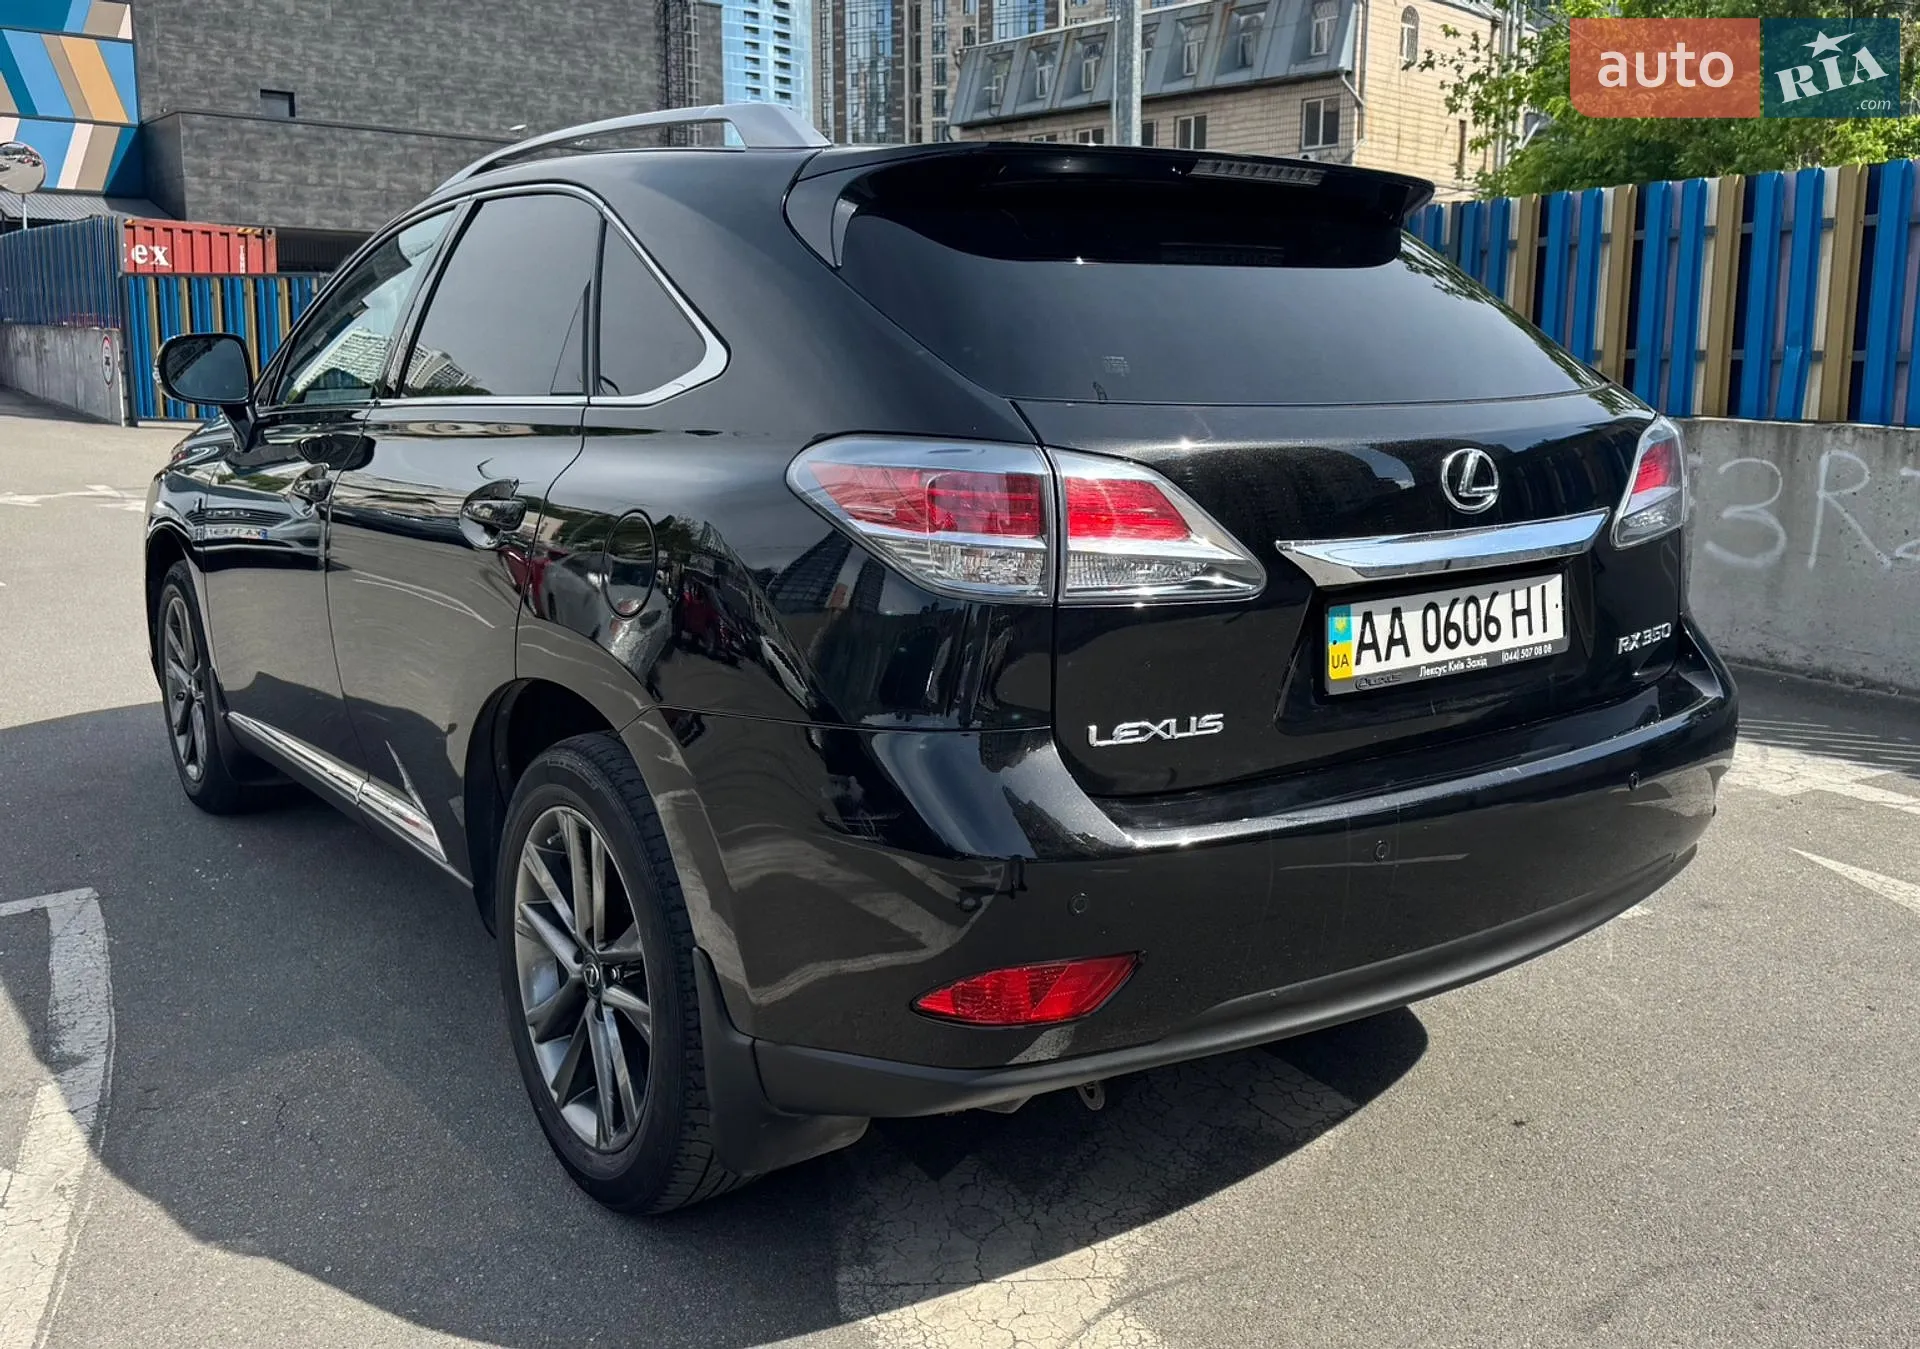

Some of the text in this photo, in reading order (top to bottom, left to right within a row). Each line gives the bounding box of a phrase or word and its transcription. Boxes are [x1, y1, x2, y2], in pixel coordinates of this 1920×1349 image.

[123, 242, 173, 269] ex
[1355, 584, 1549, 666] AA 0606 HI
[1331, 655, 1350, 669] UA
[1419, 664, 1447, 678] Лексус
[1448, 660, 1465, 673] Київ
[1465, 655, 1488, 670] Захід
[1501, 648, 1520, 664] (044)
[1520, 646, 1533, 659] 507
[1087, 713, 1225, 747] LEXUS
